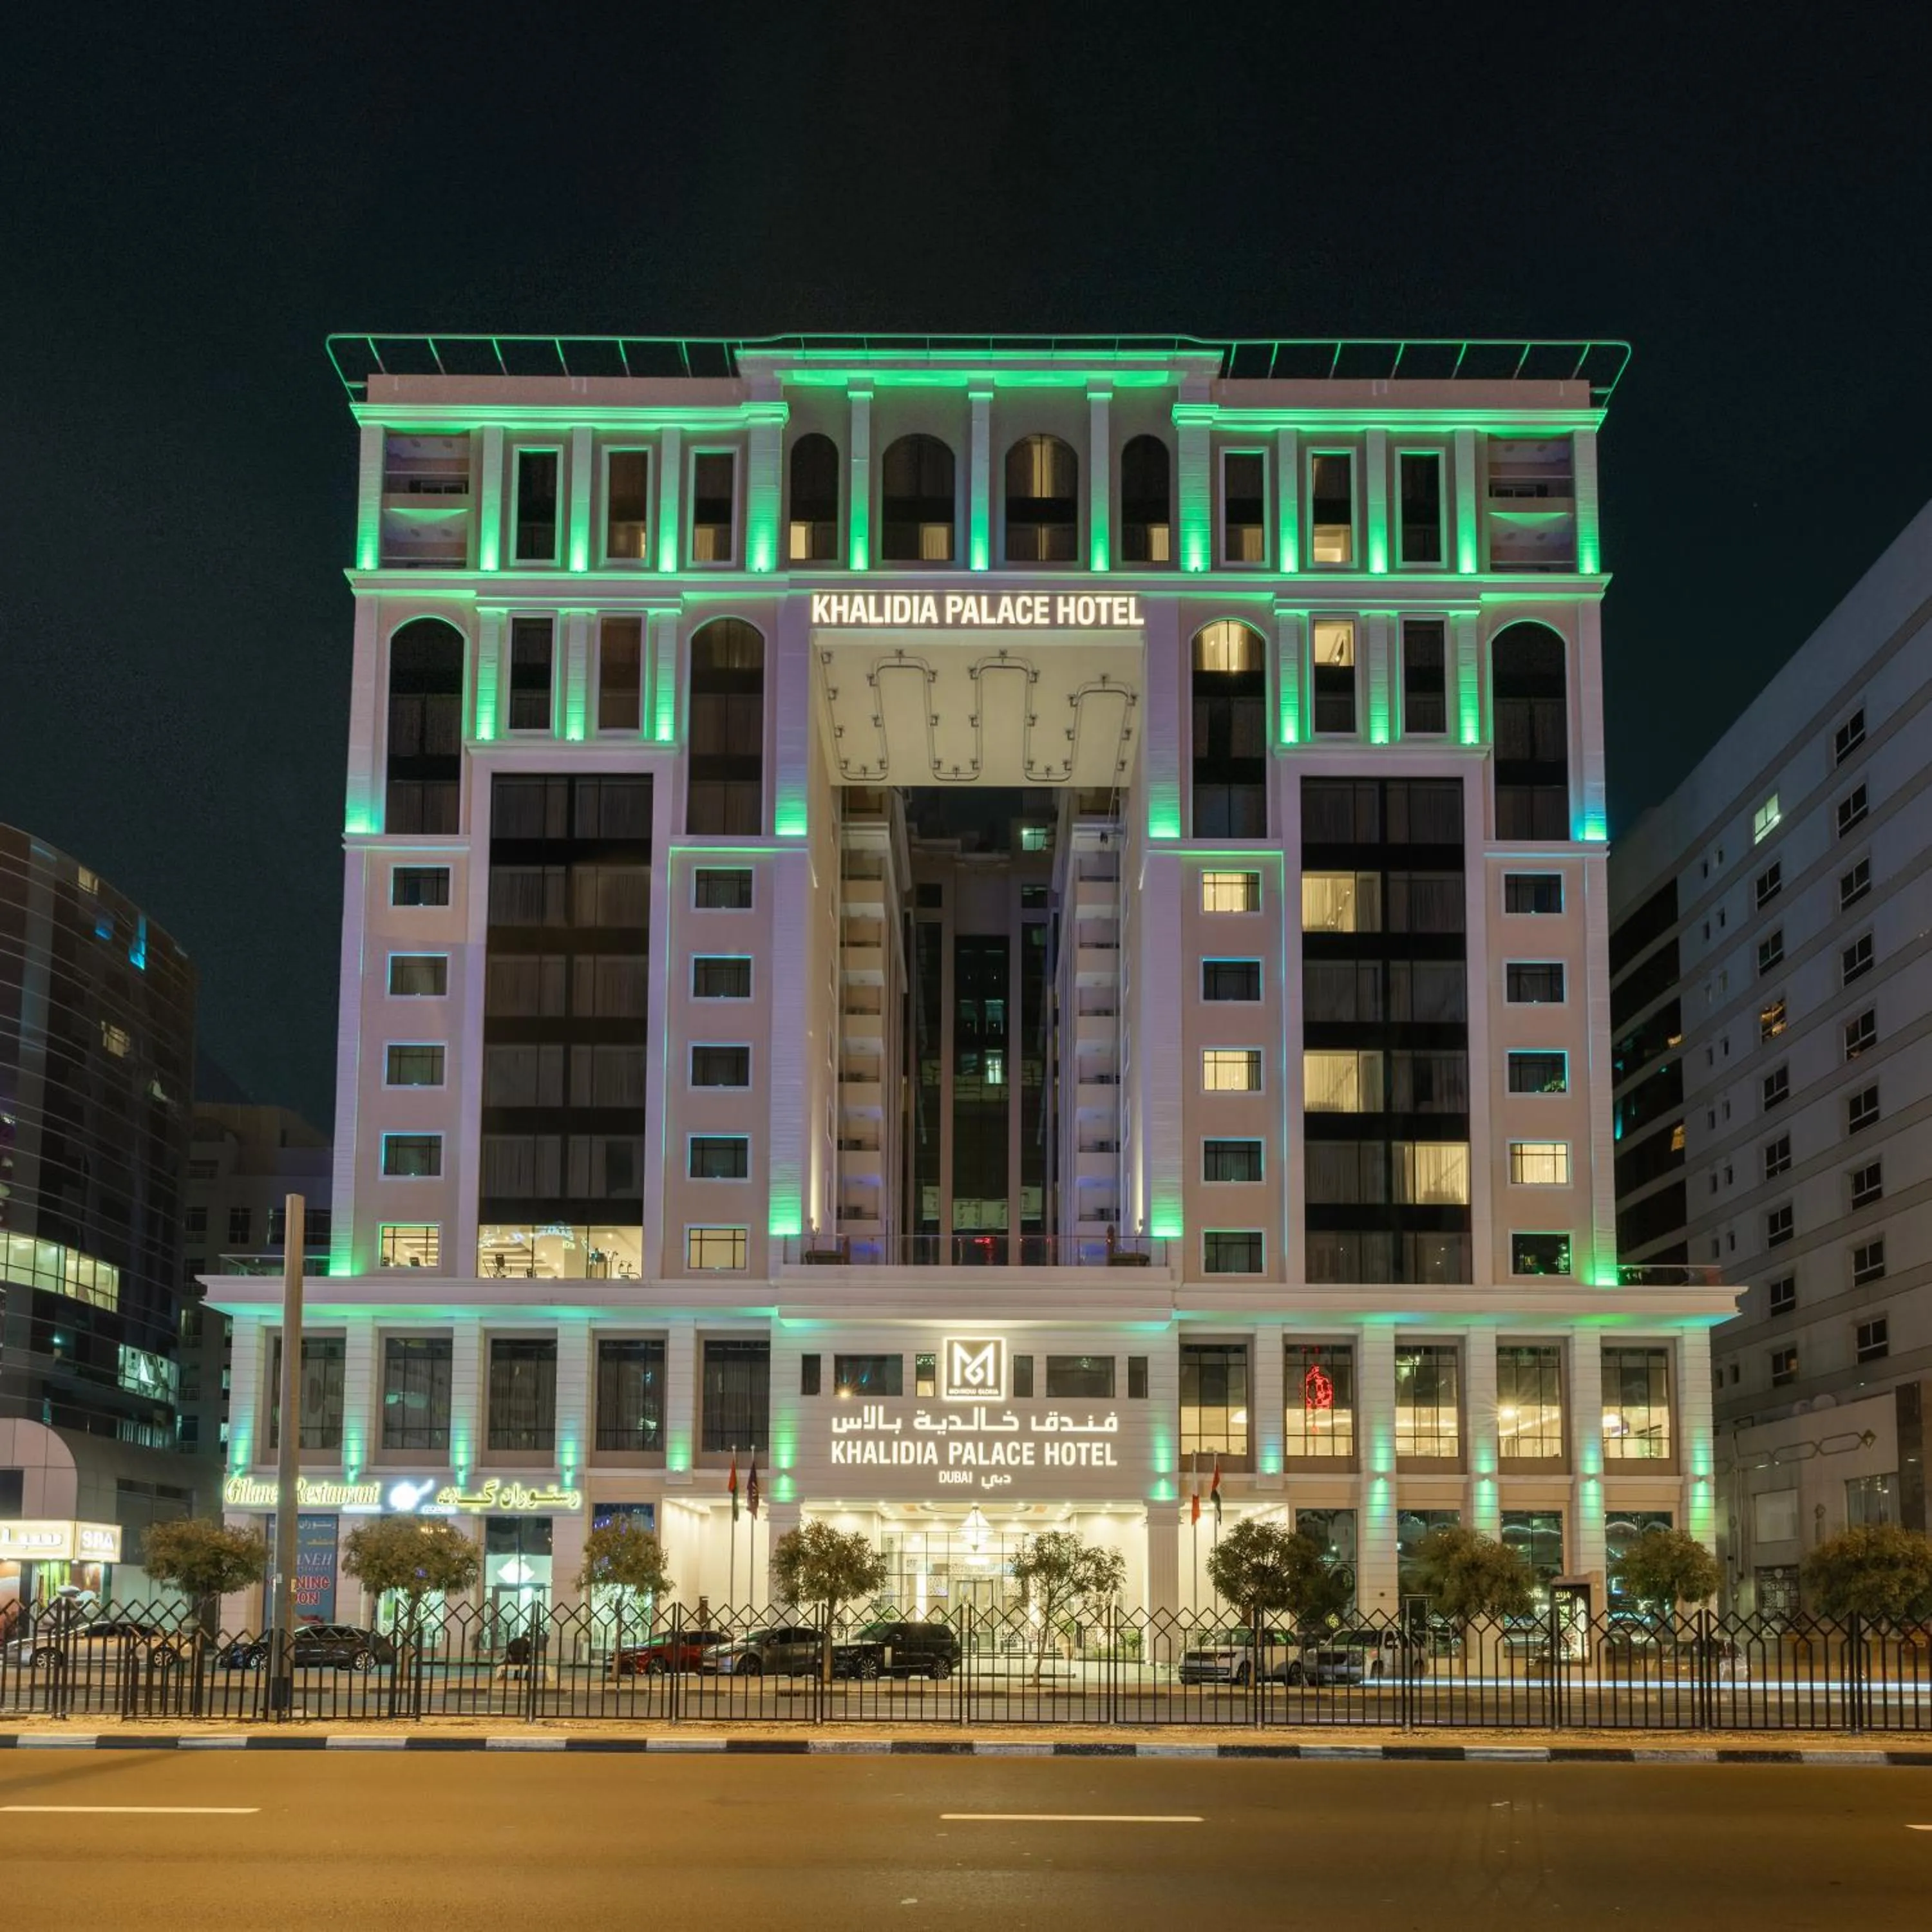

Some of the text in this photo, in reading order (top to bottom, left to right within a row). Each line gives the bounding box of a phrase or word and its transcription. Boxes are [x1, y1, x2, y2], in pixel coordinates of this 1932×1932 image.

[812, 595, 1144, 625] KHALIDIA PALACE HOTEL
[831, 1405, 1119, 1435] فندق خالدية بالاس
[831, 1441, 1118, 1466] KHALIDIA PALACE HOTEL
[225, 1475, 381, 1504] Gilane Restaurant
[939, 1470, 973, 1484] DUBAI
[981, 1474, 1012, 1490] دبي
[500, 1482, 582, 1510] رستوران
[82, 1530, 115, 1549] SPA
